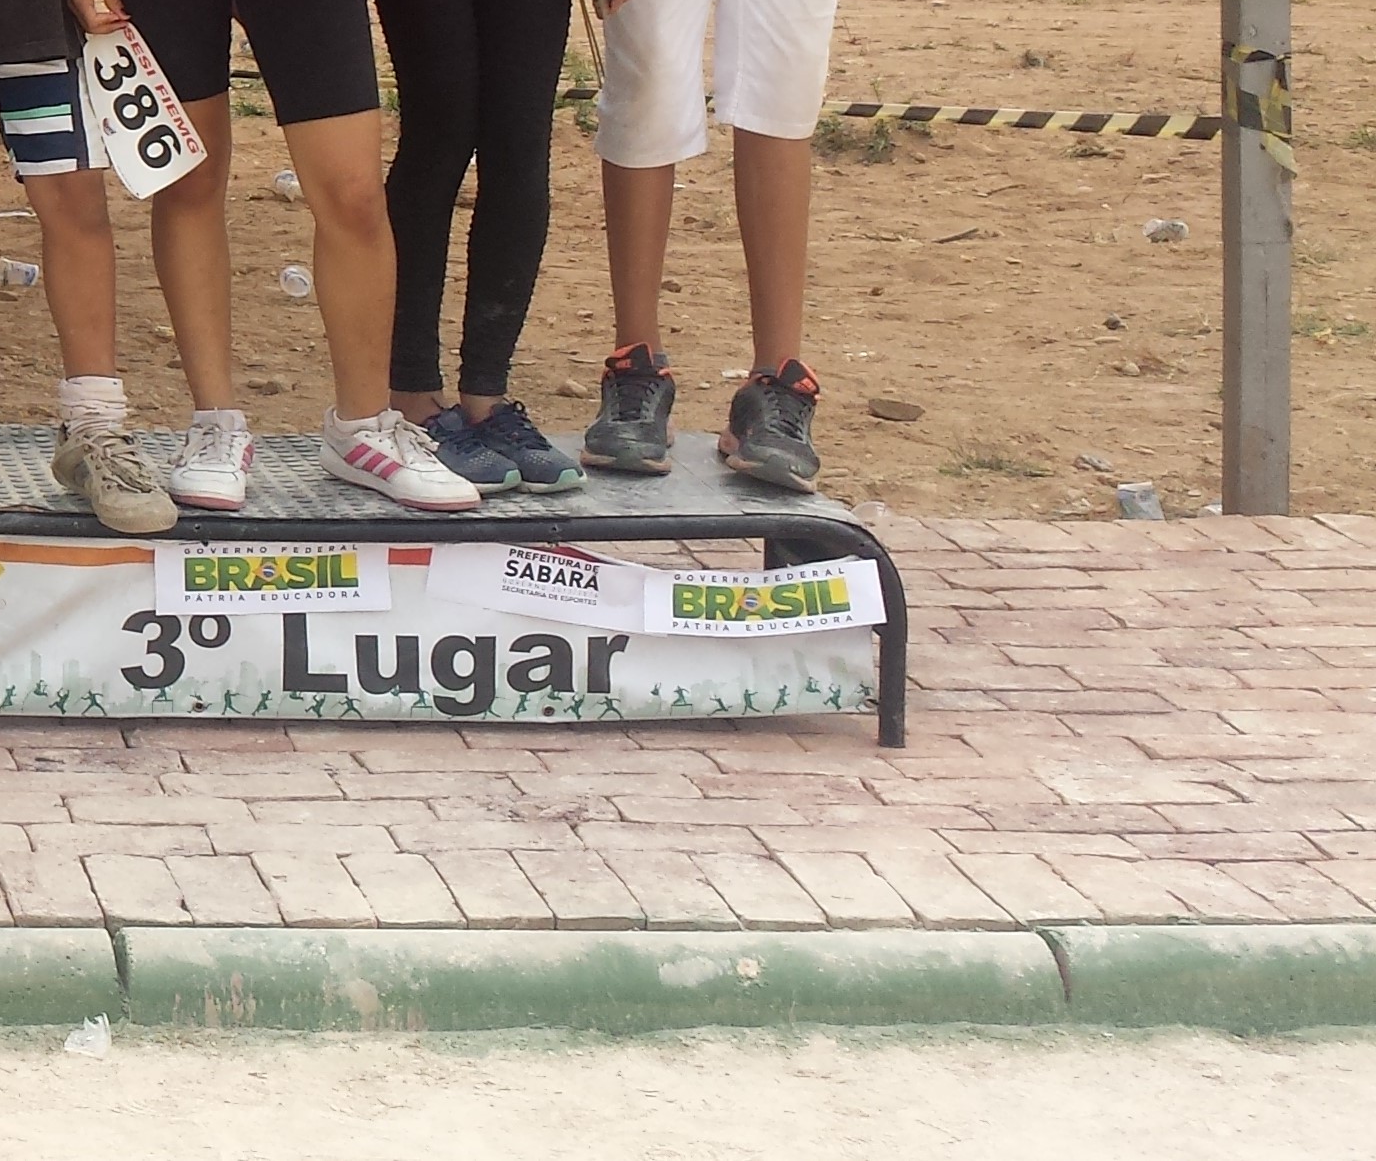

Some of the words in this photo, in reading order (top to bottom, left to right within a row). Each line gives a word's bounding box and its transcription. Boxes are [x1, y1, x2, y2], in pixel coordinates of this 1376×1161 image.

[123, 26, 157, 77] SESI
[154, 83, 199, 155] FIEMG
[94, 44, 182, 170] 386
[183, 546, 268, 555] GOVERNO
[281, 544, 358, 554] FEDERAL
[509, 548, 581, 569] PREFEITURA
[584, 563, 600, 573] DE
[184, 552, 359, 592] BRASIL
[504, 559, 600, 592] SABARÁ
[674, 573, 750, 584] GOVERNO
[763, 567, 845, 584] FEDERAL
[184, 592, 246, 602] PÁTRIA
[260, 590, 361, 602] EDUCADORA
[501, 584, 547, 598] SECRETARIA
[673, 577, 851, 621] BRASIL
[672, 620, 731, 632] PÁTRIA
[745, 614, 854, 631] EDUCADORA
[121, 609, 233, 690] 3º
[283, 613, 630, 717] Lugar
